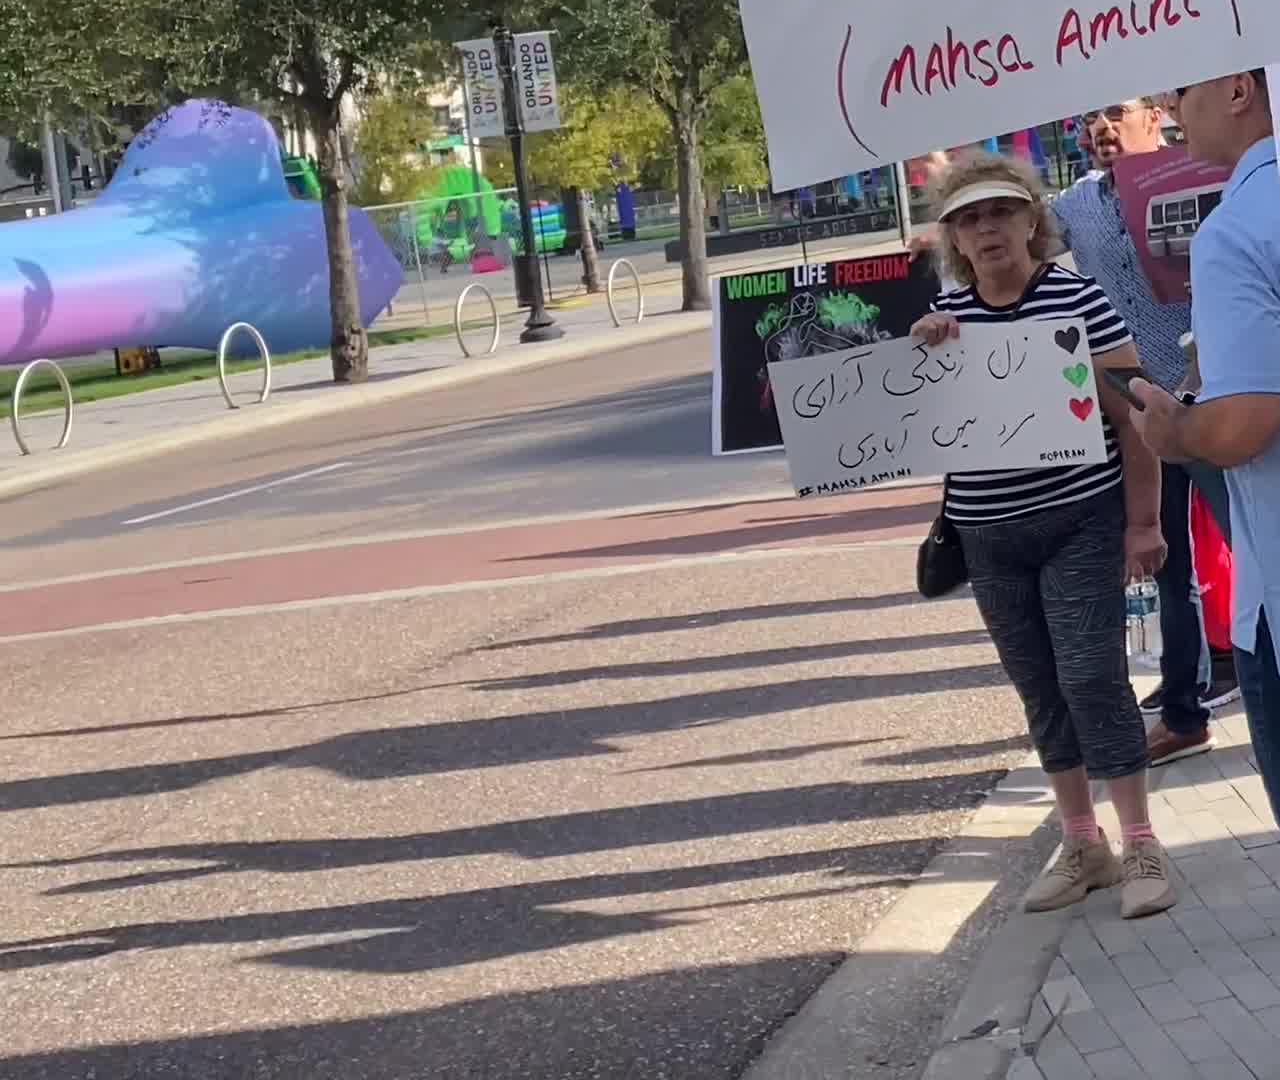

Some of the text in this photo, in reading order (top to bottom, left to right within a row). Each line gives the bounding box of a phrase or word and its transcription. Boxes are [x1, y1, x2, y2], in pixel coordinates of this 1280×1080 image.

[520, 43, 536, 108] ORLANDO
[794, 264, 827, 287] LIFE
[835, 256, 910, 285] FREEDOM
